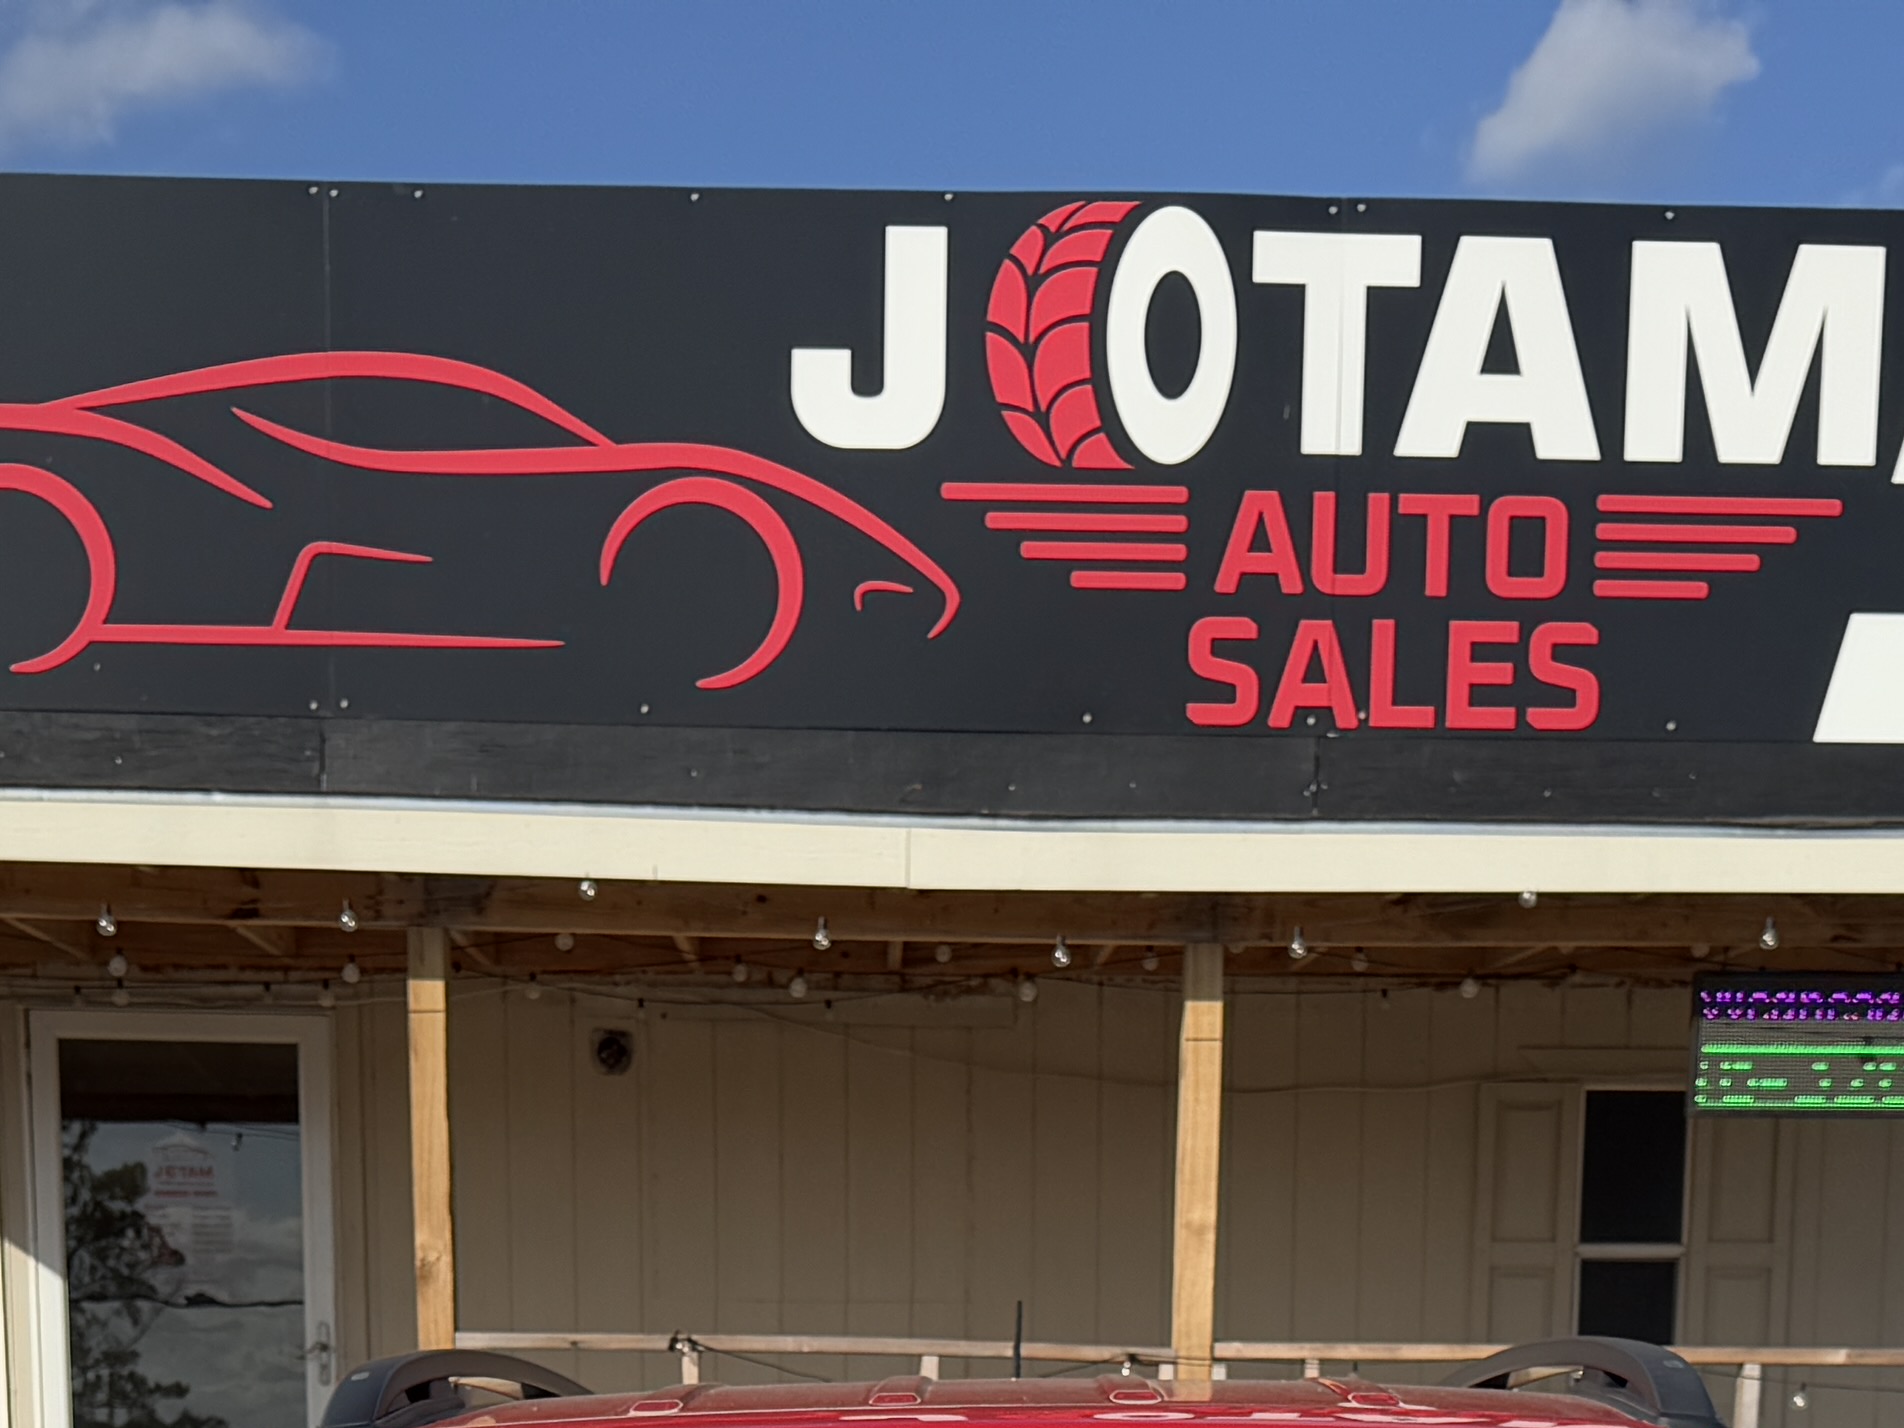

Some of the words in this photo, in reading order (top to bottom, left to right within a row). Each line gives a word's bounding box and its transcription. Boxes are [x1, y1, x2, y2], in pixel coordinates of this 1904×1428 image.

[790, 200, 1887, 467] JOTAM
[1213, 490, 1569, 599] AUTO
[1185, 616, 1600, 730] SALES
